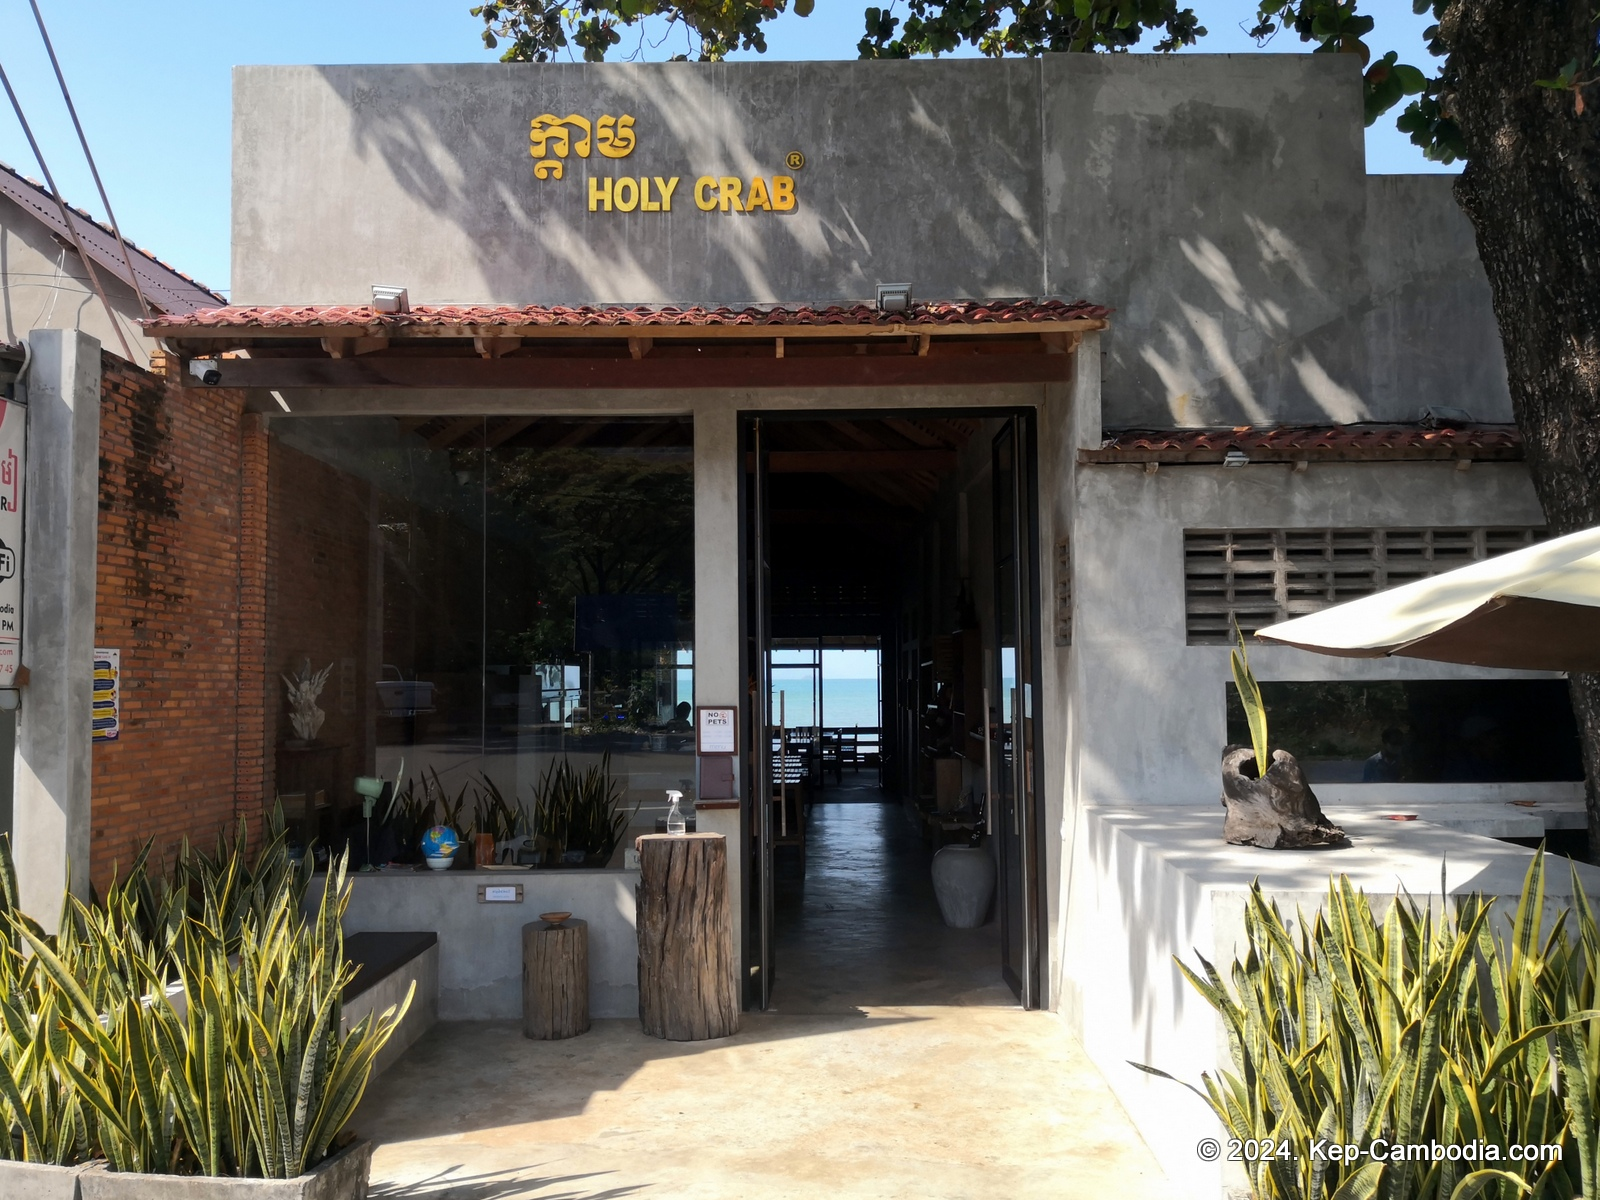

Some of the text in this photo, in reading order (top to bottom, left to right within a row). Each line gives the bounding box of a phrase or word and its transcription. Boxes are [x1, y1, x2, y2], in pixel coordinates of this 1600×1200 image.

[588, 175, 797, 212] HOLY CRAB
[1, 620, 14, 631] PM
[5, 664, 13, 673] 45
